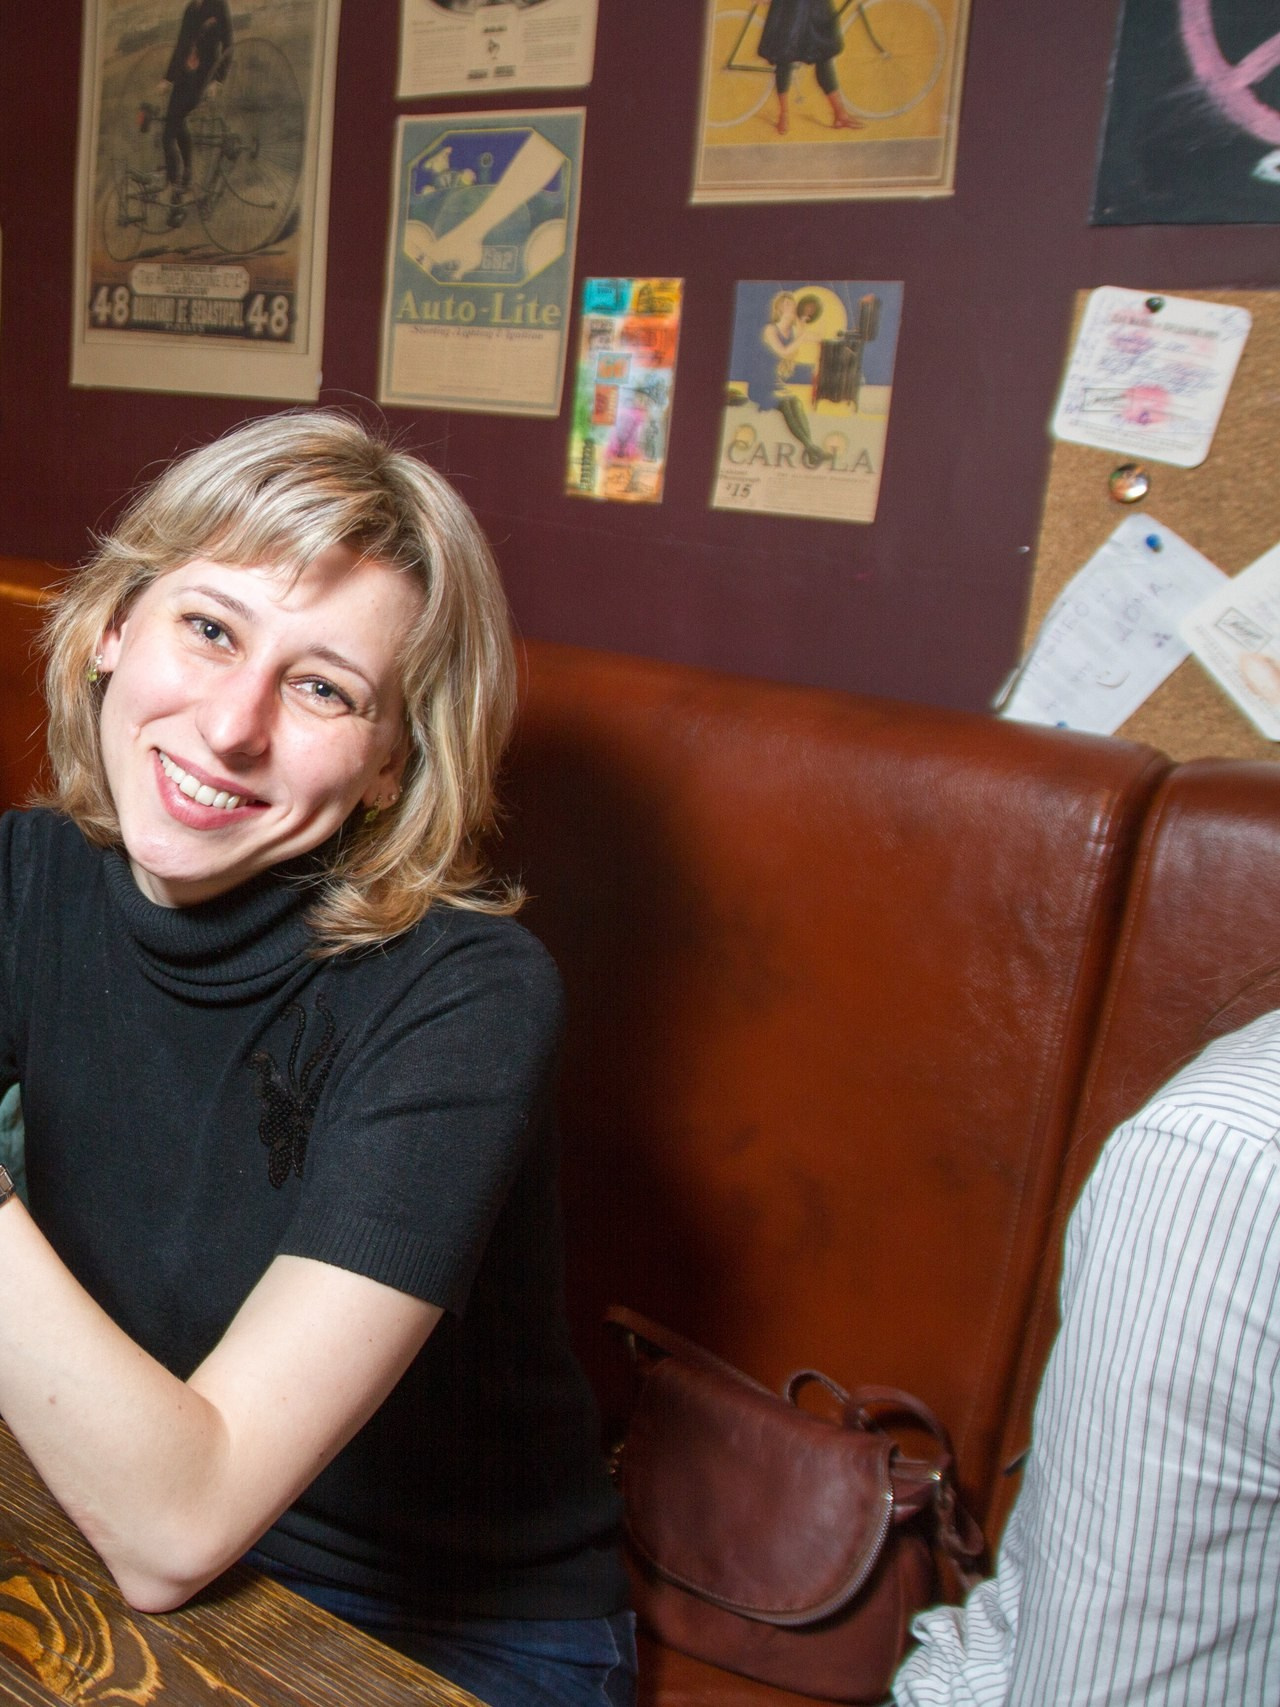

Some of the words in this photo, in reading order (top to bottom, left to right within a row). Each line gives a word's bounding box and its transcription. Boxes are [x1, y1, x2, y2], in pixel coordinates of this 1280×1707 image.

[91, 285, 130, 327] 48
[247, 293, 290, 336] 48
[395, 289, 562, 326] Auto-Lite
[726, 439, 876, 475] CAROLA
